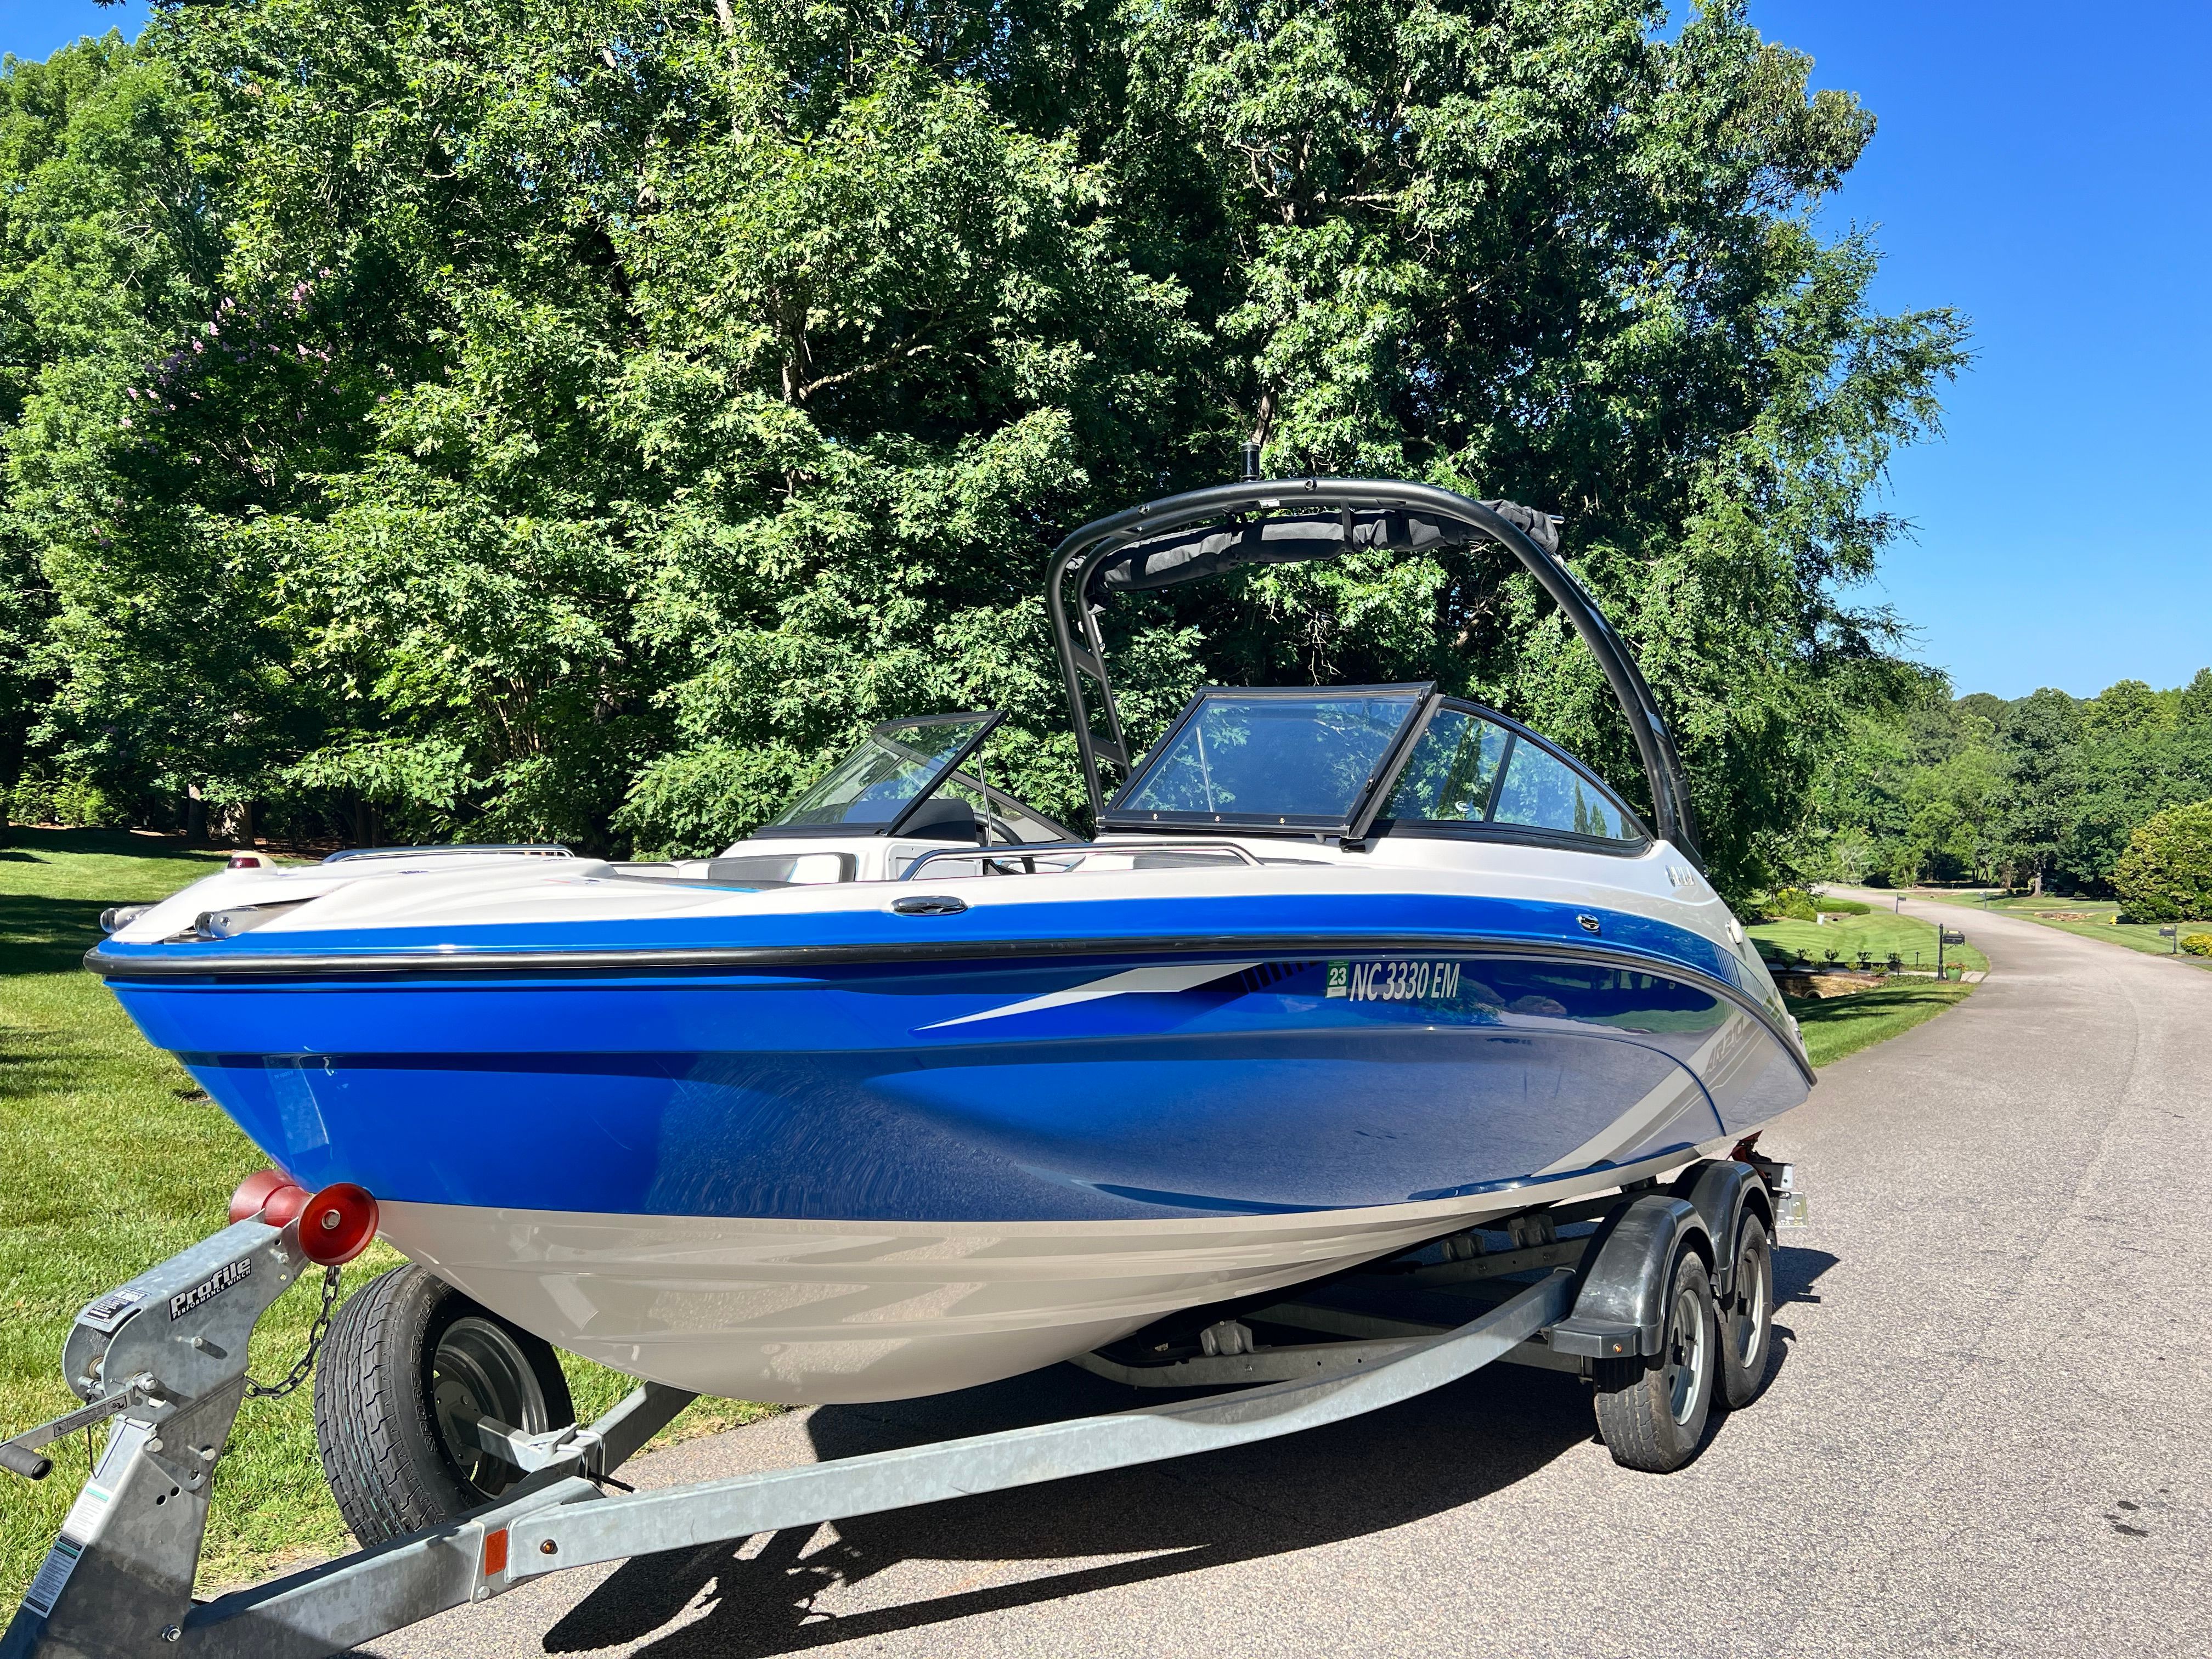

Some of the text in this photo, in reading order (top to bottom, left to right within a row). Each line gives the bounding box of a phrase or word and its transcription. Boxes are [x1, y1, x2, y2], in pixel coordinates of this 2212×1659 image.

[1329, 967, 1346, 985] 23
[1350, 962, 1460, 1002] NC 3330 EM
[171, 1257, 251, 1314] Profile
[173, 1285, 225, 1319] PERFORMANCE
[227, 1269, 251, 1286] WINCH
[410, 1307, 432, 1364] TRAIL
[410, 1371, 438, 1453] SPORT
